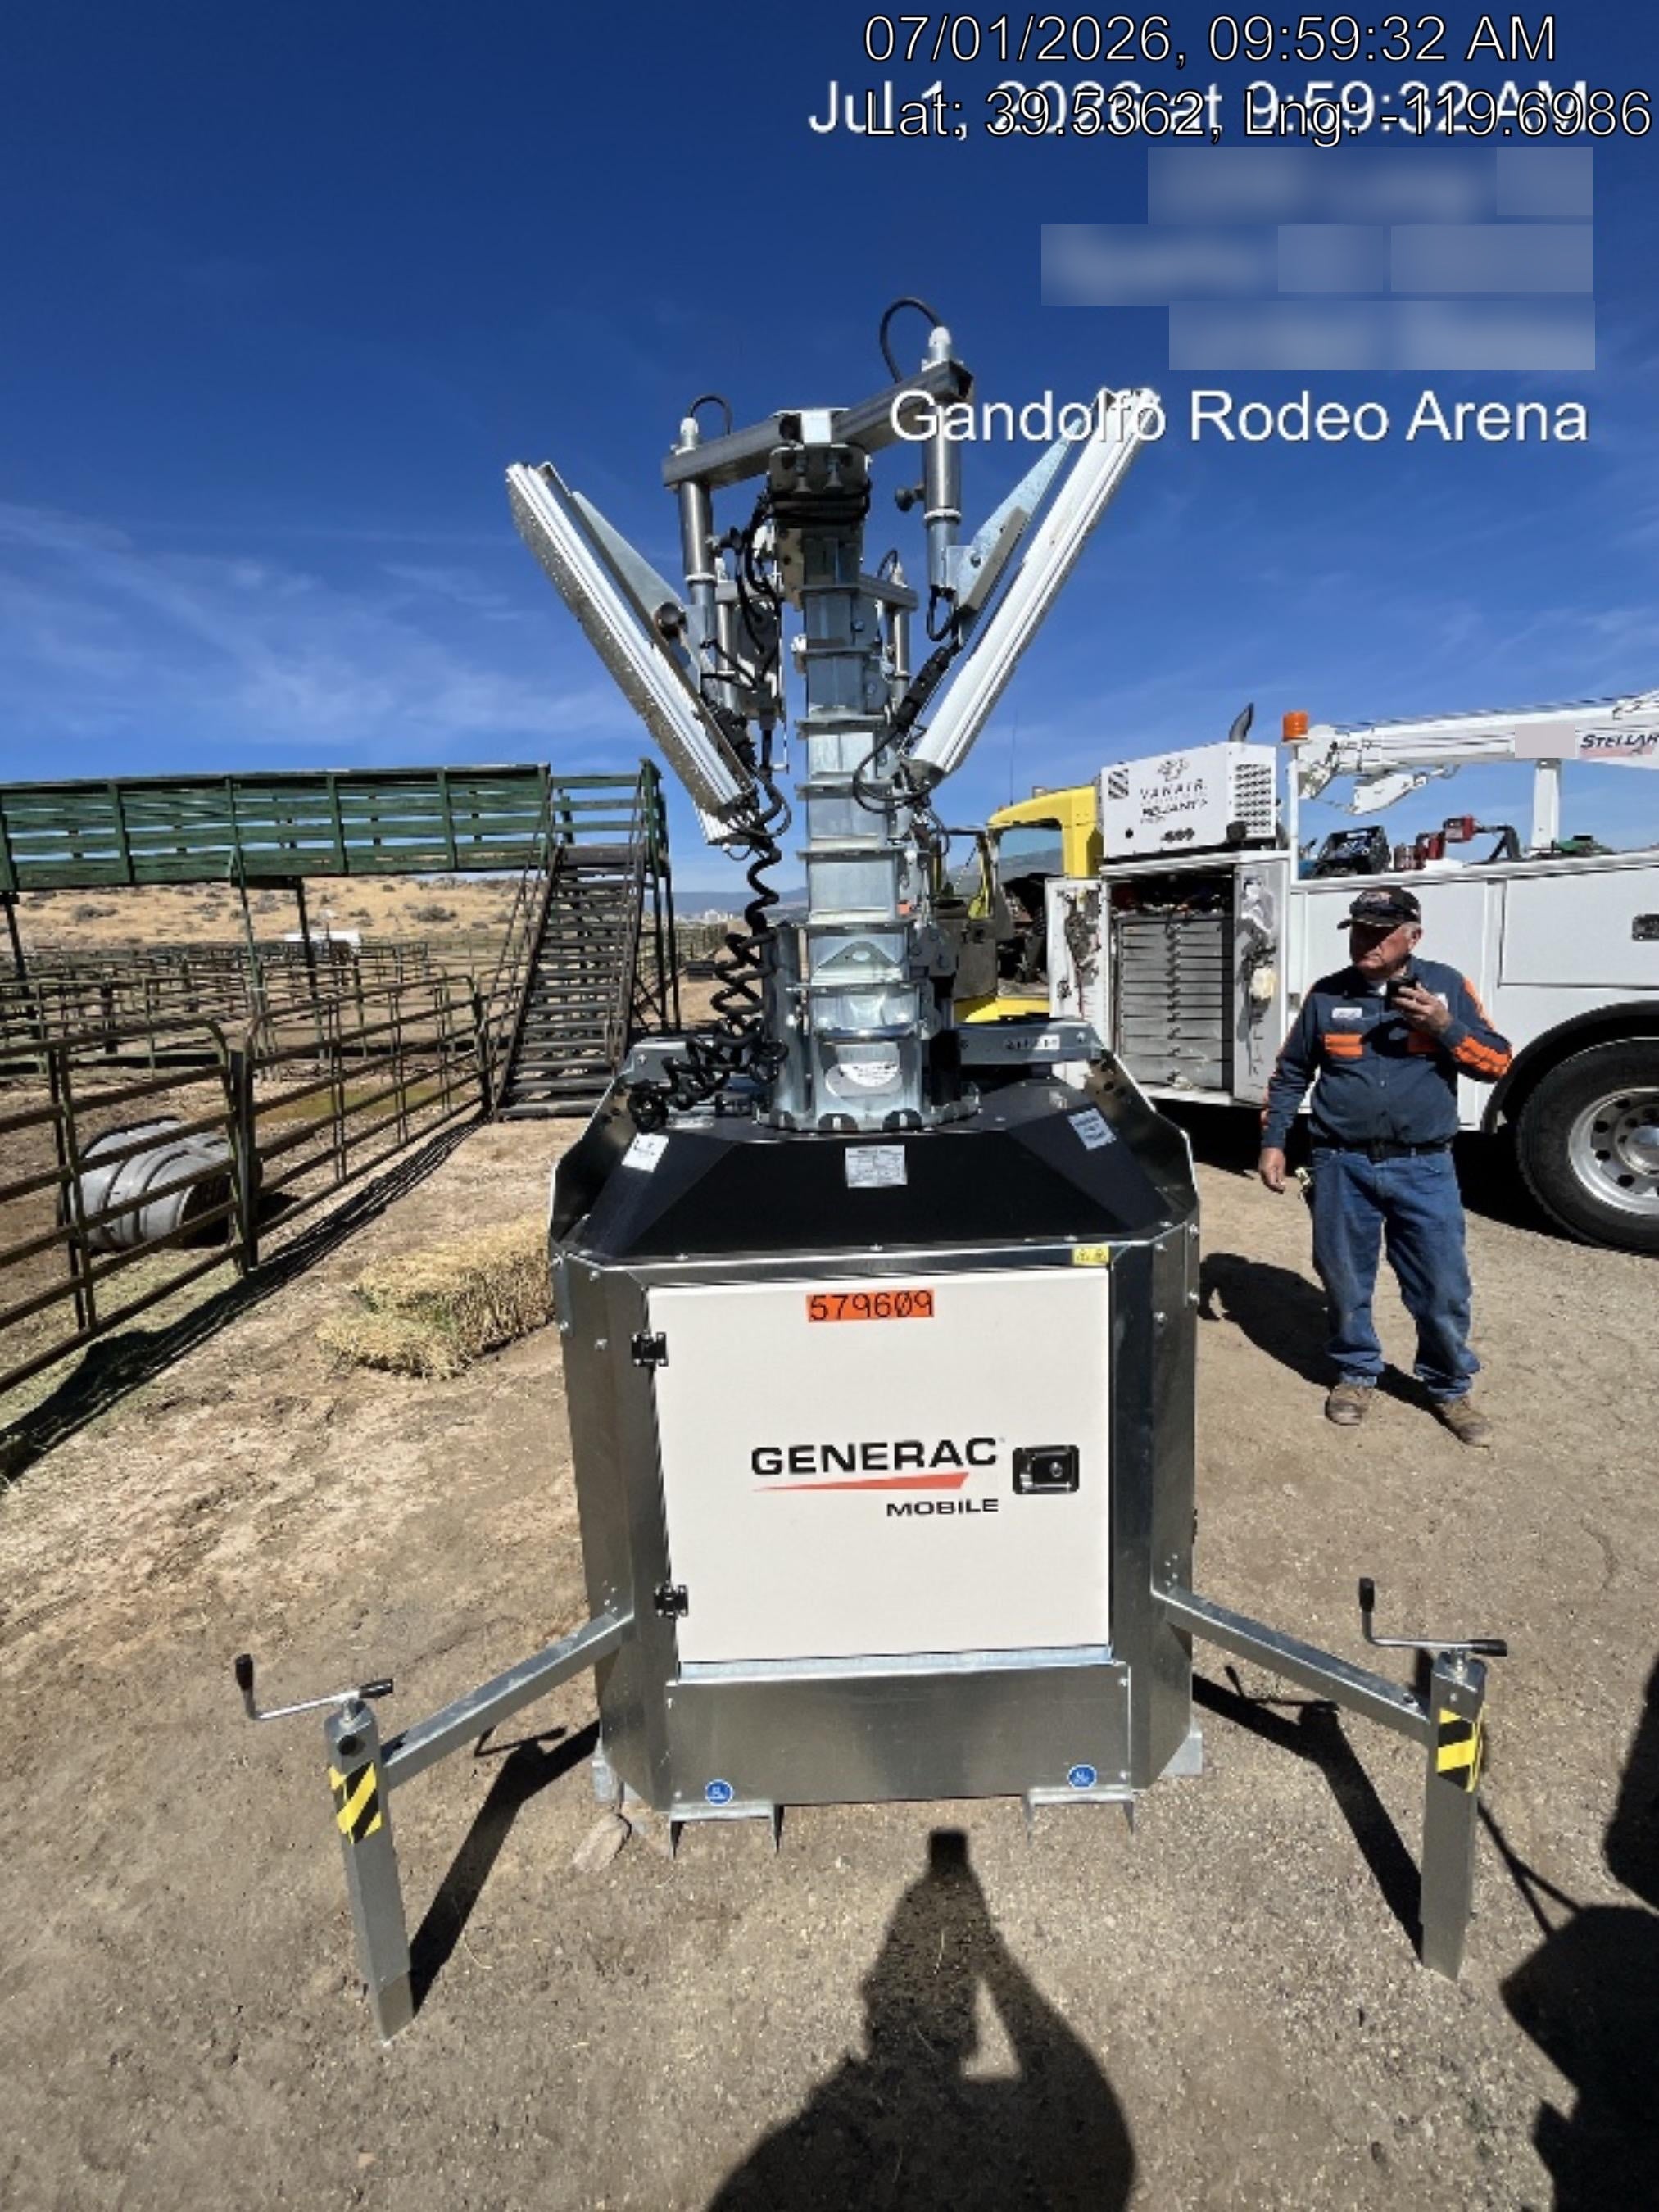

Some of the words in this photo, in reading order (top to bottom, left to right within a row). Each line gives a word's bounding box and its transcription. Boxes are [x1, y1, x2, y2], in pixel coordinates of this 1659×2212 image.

[809, 1290, 933, 1321] 579609
[751, 1437, 997, 1475] GENERAC
[886, 1498, 999, 1517] MOBILE
